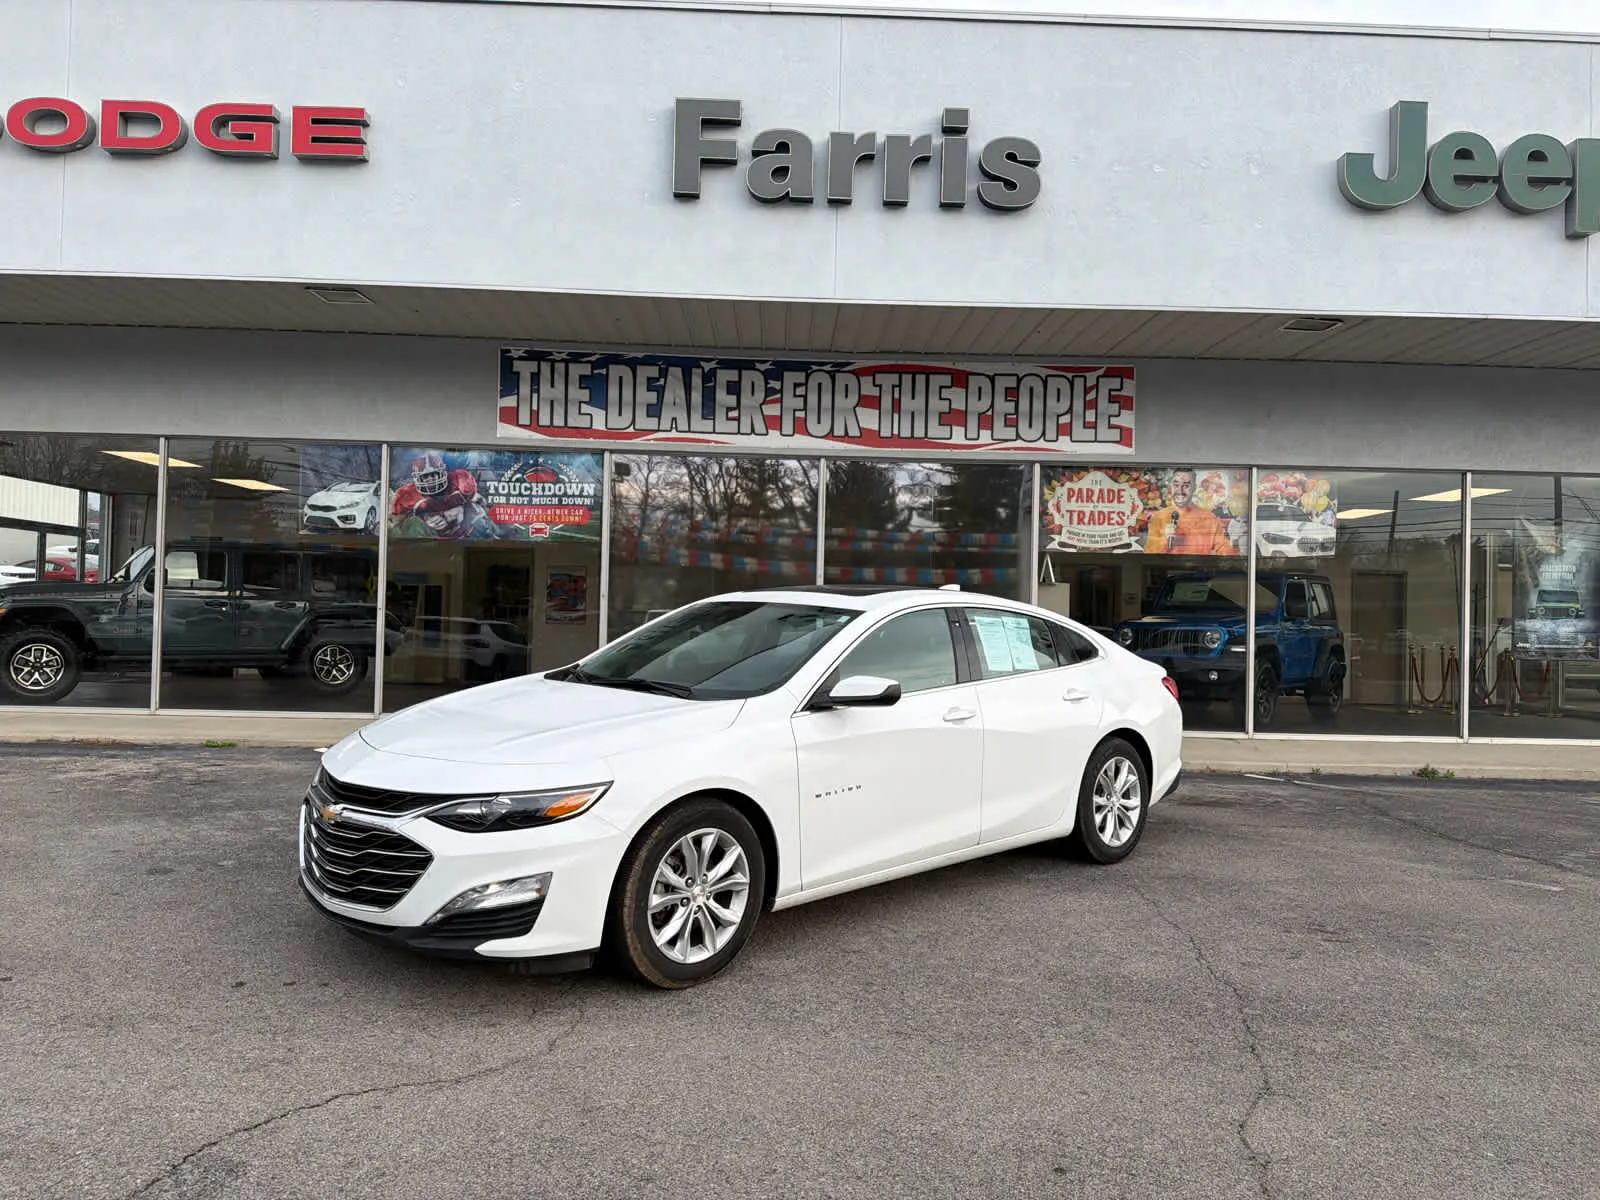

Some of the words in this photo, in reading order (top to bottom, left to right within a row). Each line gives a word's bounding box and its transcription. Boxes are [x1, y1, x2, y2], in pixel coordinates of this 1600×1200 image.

[0, 97, 371, 163] ODGE
[673, 97, 1042, 210] Farris
[512, 359, 592, 429] THE
[605, 363, 769, 436] DEALER
[779, 367, 862, 440] FOR
[872, 371, 953, 440] THE
[963, 373, 1124, 443] PEOPLE
[486, 481, 597, 496] TOUCHDOWN
[1066, 487, 1126, 504] PARADE
[488, 495, 506, 504] FOR
[510, 496, 529, 505] NOT
[533, 497, 558, 505] MUCH
[562, 497, 594, 505] DOWN!
[1065, 509, 1126, 526] TRADES
[815, 784, 862, 798] MALIBU
